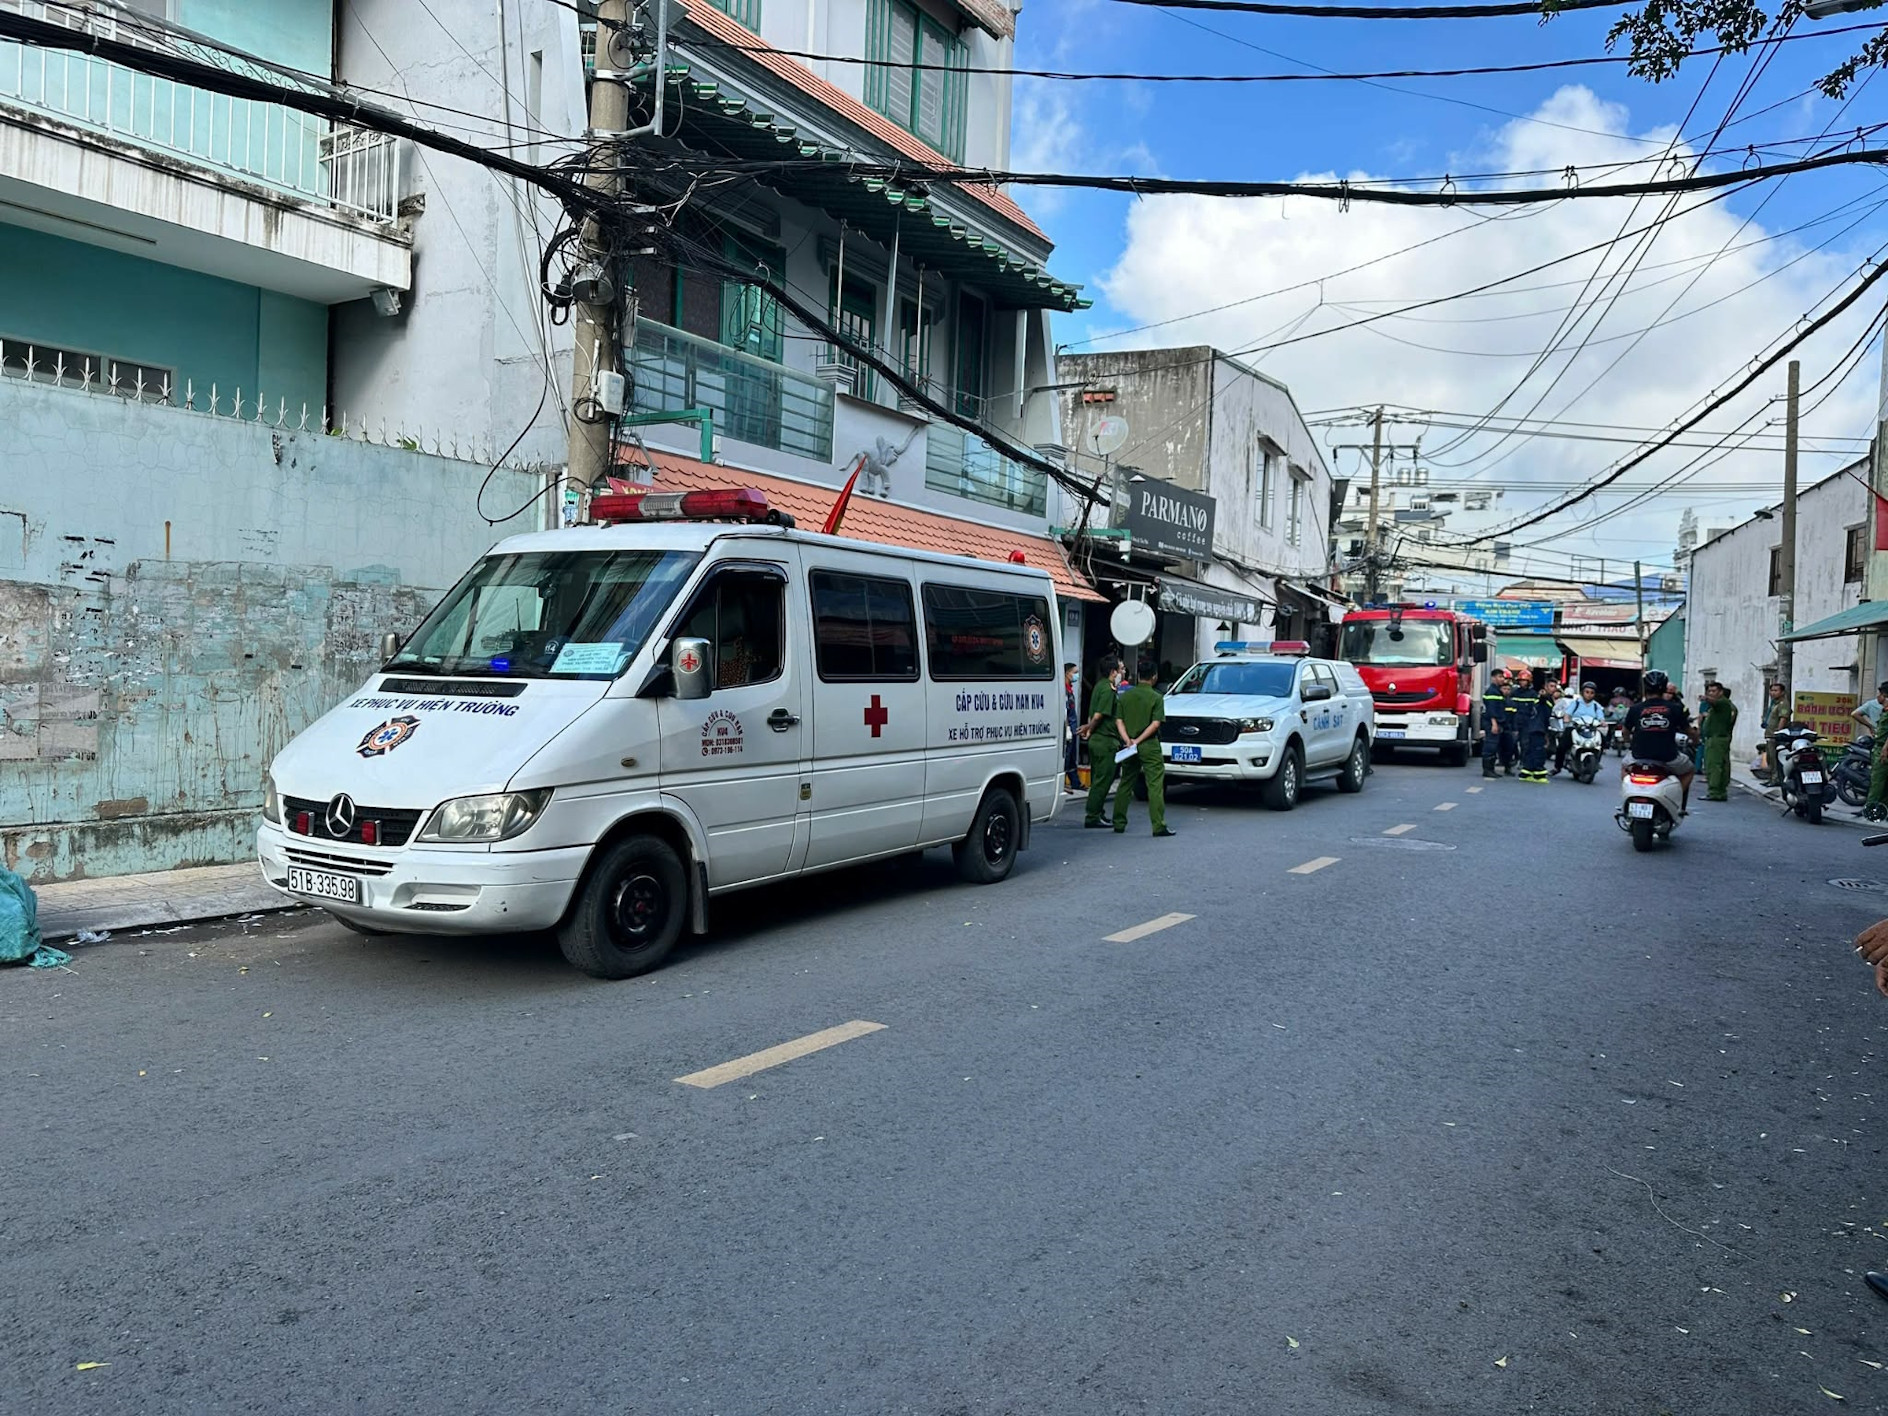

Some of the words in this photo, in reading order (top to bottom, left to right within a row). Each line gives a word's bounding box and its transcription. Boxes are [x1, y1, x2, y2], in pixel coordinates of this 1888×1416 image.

[1176, 531, 1206, 545] coffee
[415, 698, 453, 713] HIỆN
[948, 728, 958, 740] XE
[1174, 753, 1199, 761] 021.02
[291, 870, 355, 899] 51B-335.98
